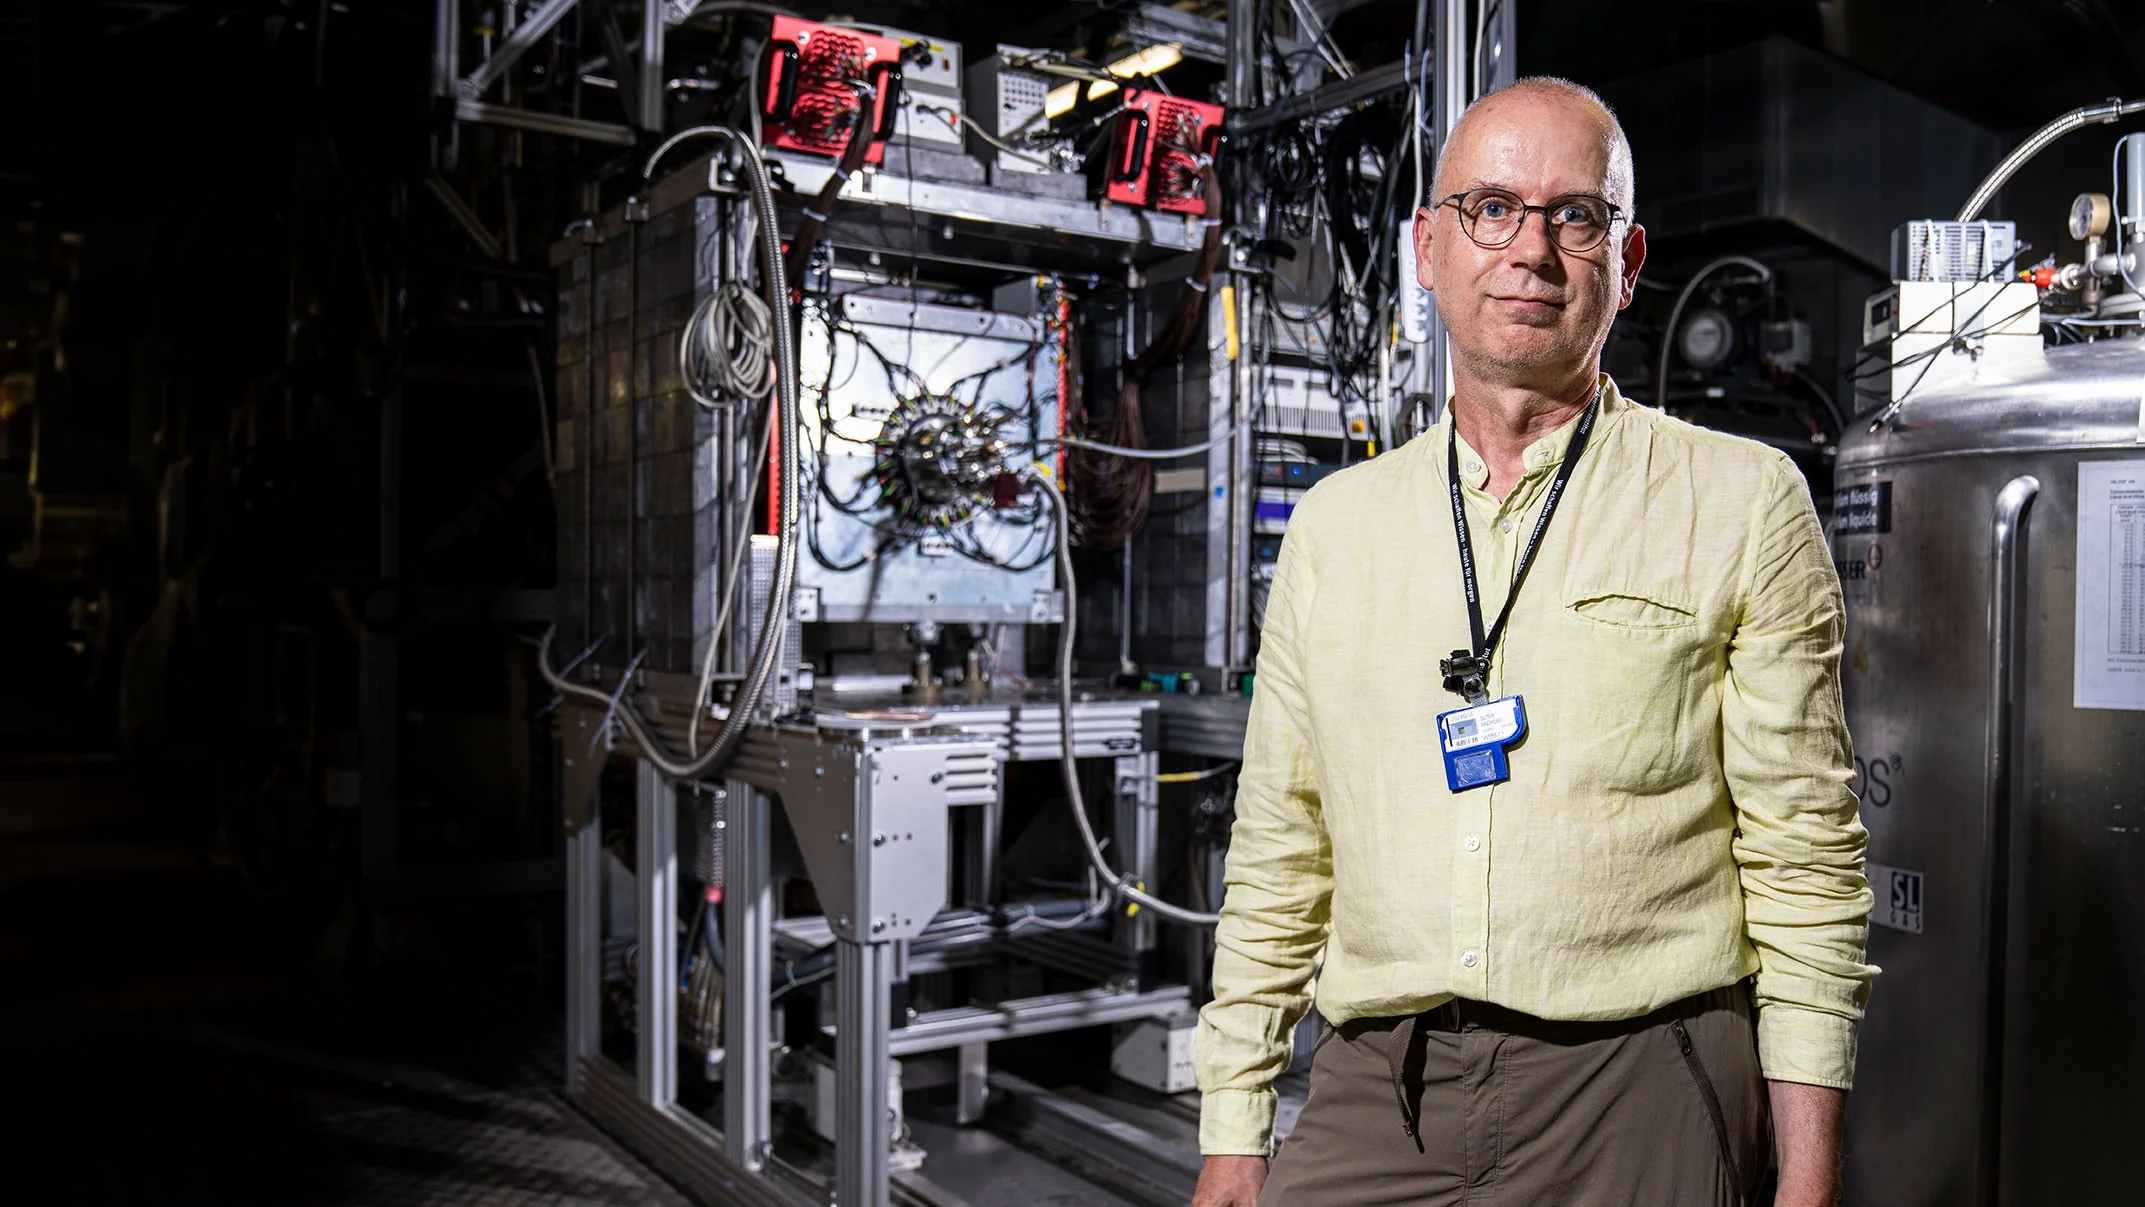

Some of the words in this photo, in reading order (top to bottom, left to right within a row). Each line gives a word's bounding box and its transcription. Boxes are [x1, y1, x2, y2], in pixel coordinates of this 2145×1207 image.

[1556, 479, 1564, 490] Wir
[1452, 494, 1462, 519] schaffen
[1542, 491, 1557, 516] schaffen
[1456, 519, 1466, 542] Wissen
[1532, 517, 1545, 540] Wissen
[1461, 548, 1470, 567] heute
[1464, 567, 1472, 577] für
[1464, 577, 1475, 602] morgen
[1893, 874, 1919, 913] SL
